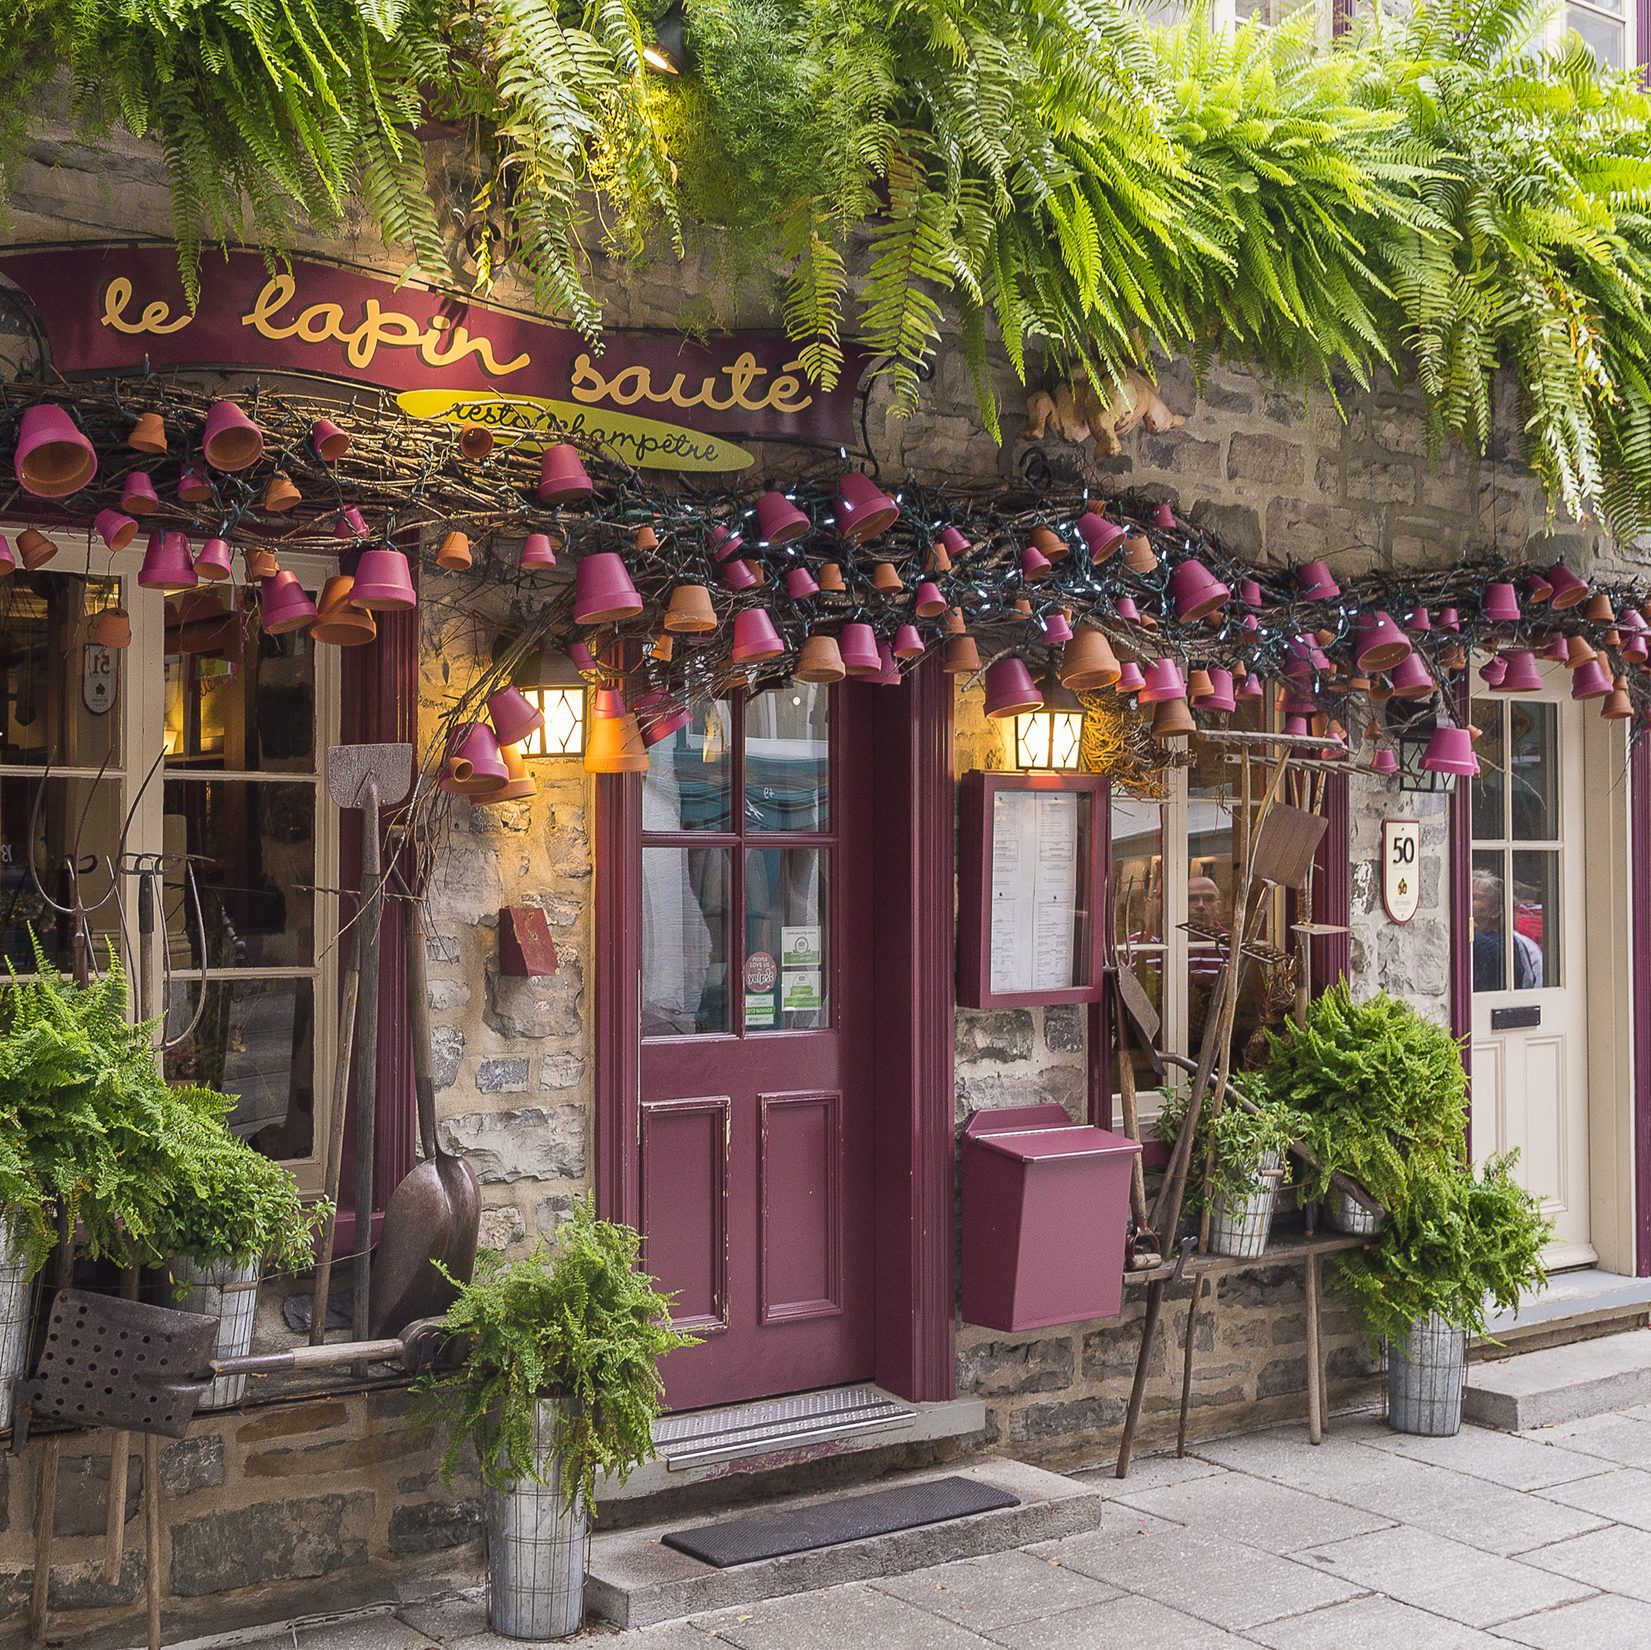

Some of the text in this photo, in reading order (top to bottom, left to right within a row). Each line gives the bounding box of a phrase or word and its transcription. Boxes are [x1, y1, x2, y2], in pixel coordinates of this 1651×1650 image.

[100, 274, 813, 413] le lapin sauté
[1392, 836, 1415, 864] 50
[748, 971, 766, 985] yelp
